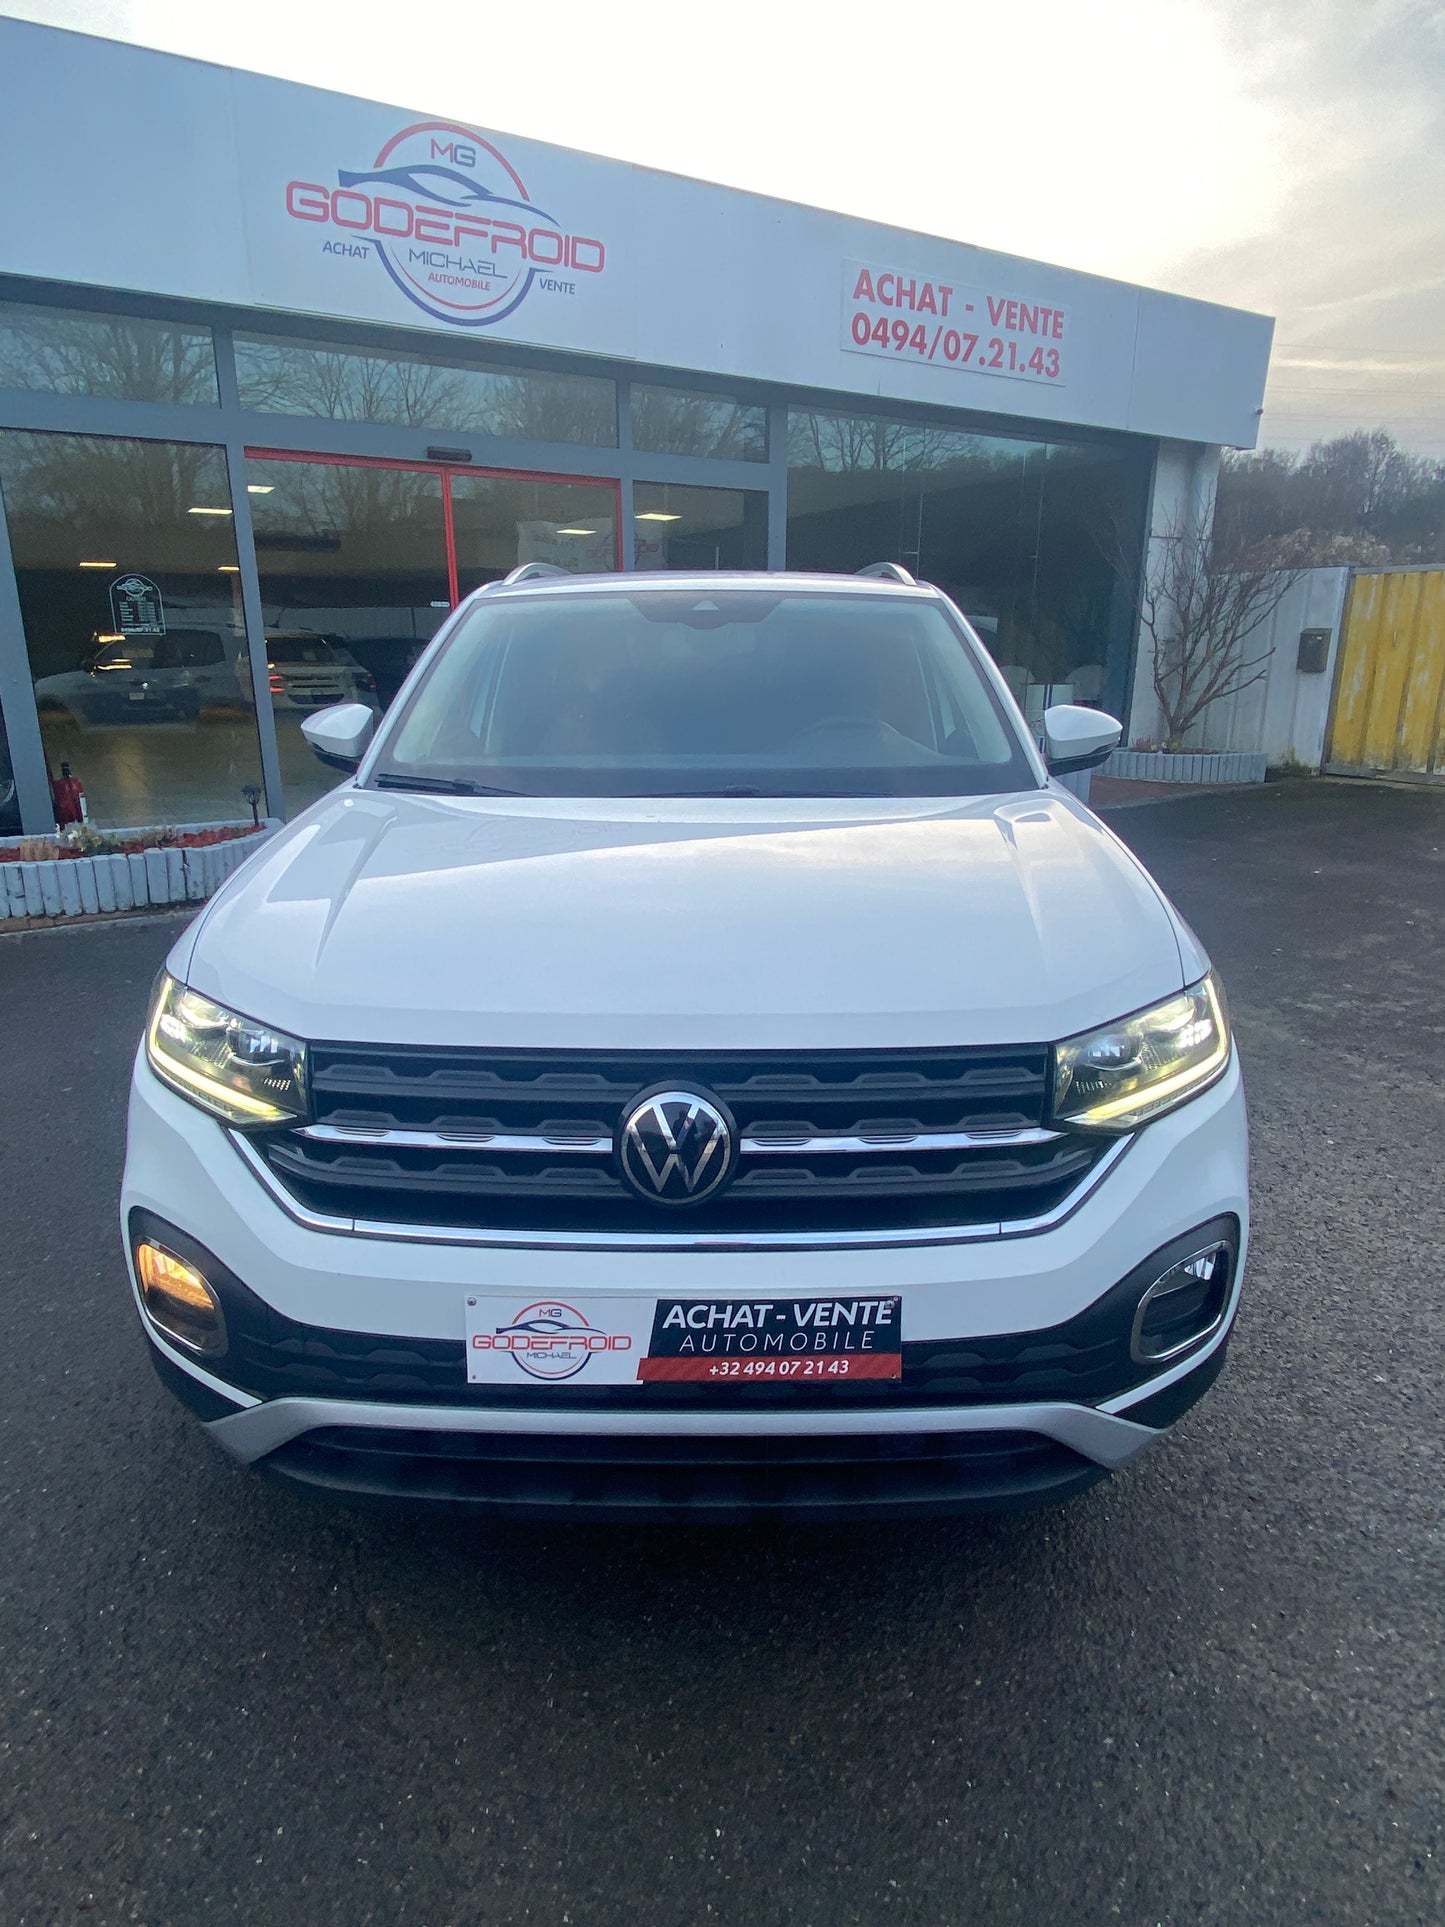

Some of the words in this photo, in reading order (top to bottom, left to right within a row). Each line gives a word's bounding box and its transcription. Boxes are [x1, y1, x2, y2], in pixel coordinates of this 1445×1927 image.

[430, 138, 476, 167] MG
[286, 180, 605, 272] GODEFROID
[322, 240, 370, 259] ACHAT
[409, 248, 508, 279] MICHAEL
[428, 271, 491, 292] AUTOMOBILE
[539, 277, 576, 295] VENTE
[853, 268, 953, 317] ACHAT
[986, 295, 1065, 340] VENTE
[851, 312, 1061, 378] 0494/07.21.43
[538, 1308, 562, 1318] MG
[662, 1303, 775, 1330] ACHAT
[793, 1300, 895, 1327] VENTE
[472, 1334, 632, 1351] GODEFROID
[679, 1330, 875, 1352] AUTOMOBILE
[526, 1351, 577, 1360] MICHAEL
[709, 1361, 740, 1376] +32
[743, 1361, 776, 1376] 494
[778, 1360, 800, 1375] 07
[803, 1360, 824, 1375] 21
[828, 1359, 850, 1374] 43
